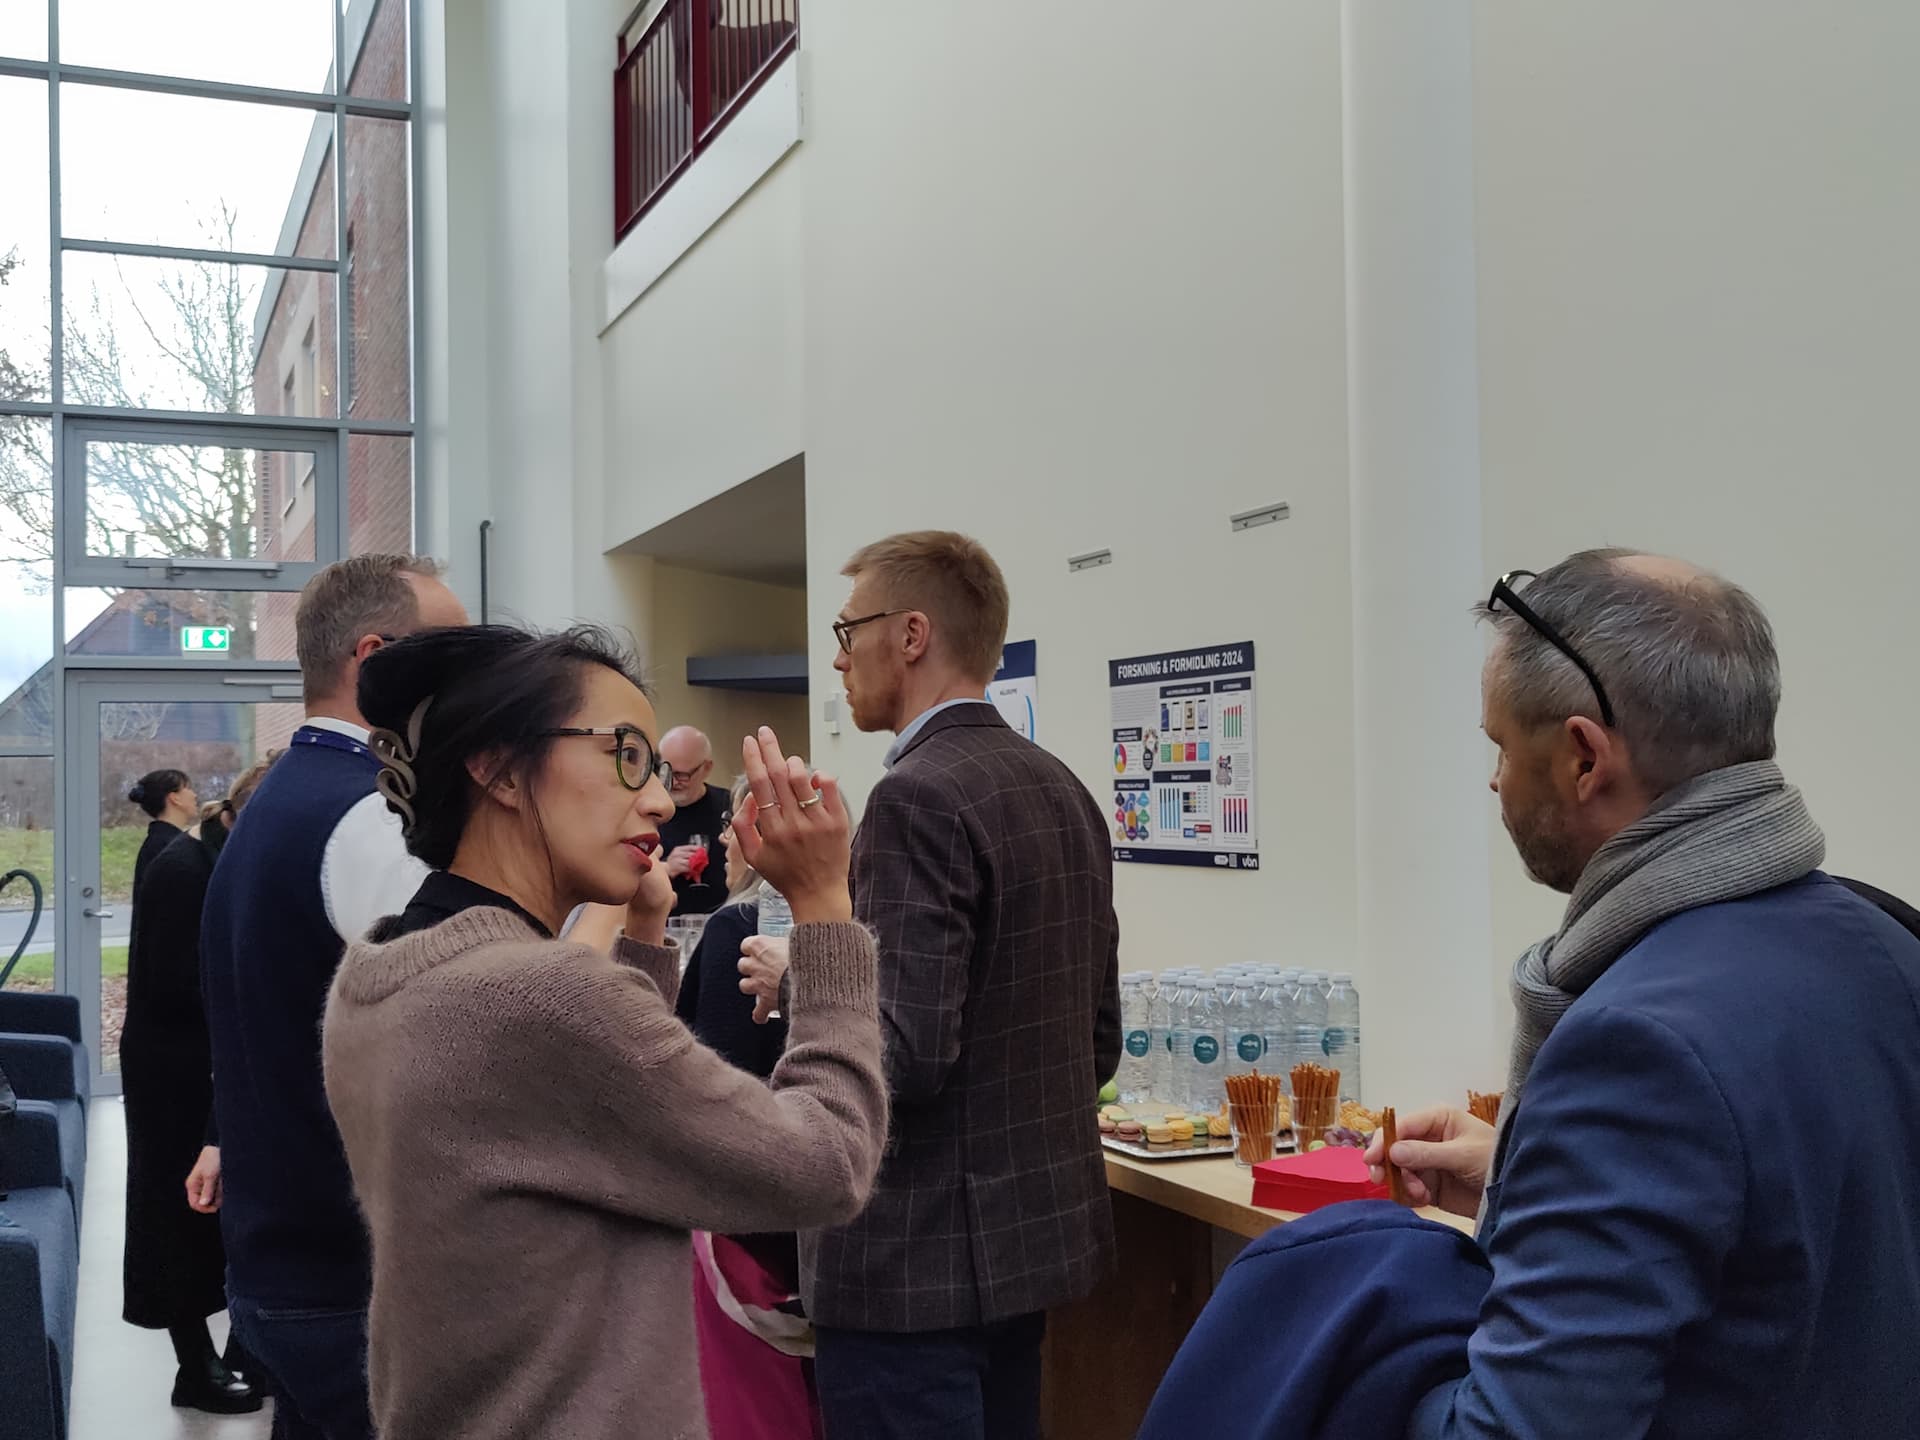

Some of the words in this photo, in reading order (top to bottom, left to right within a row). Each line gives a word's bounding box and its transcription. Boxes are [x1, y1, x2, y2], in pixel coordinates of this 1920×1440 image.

[1118, 661, 1161, 679] FORSKNING
[1162, 660, 1168, 674] &
[1169, 653, 1220, 672] FORMIDLING
[1222, 650, 1243, 667] 2024
